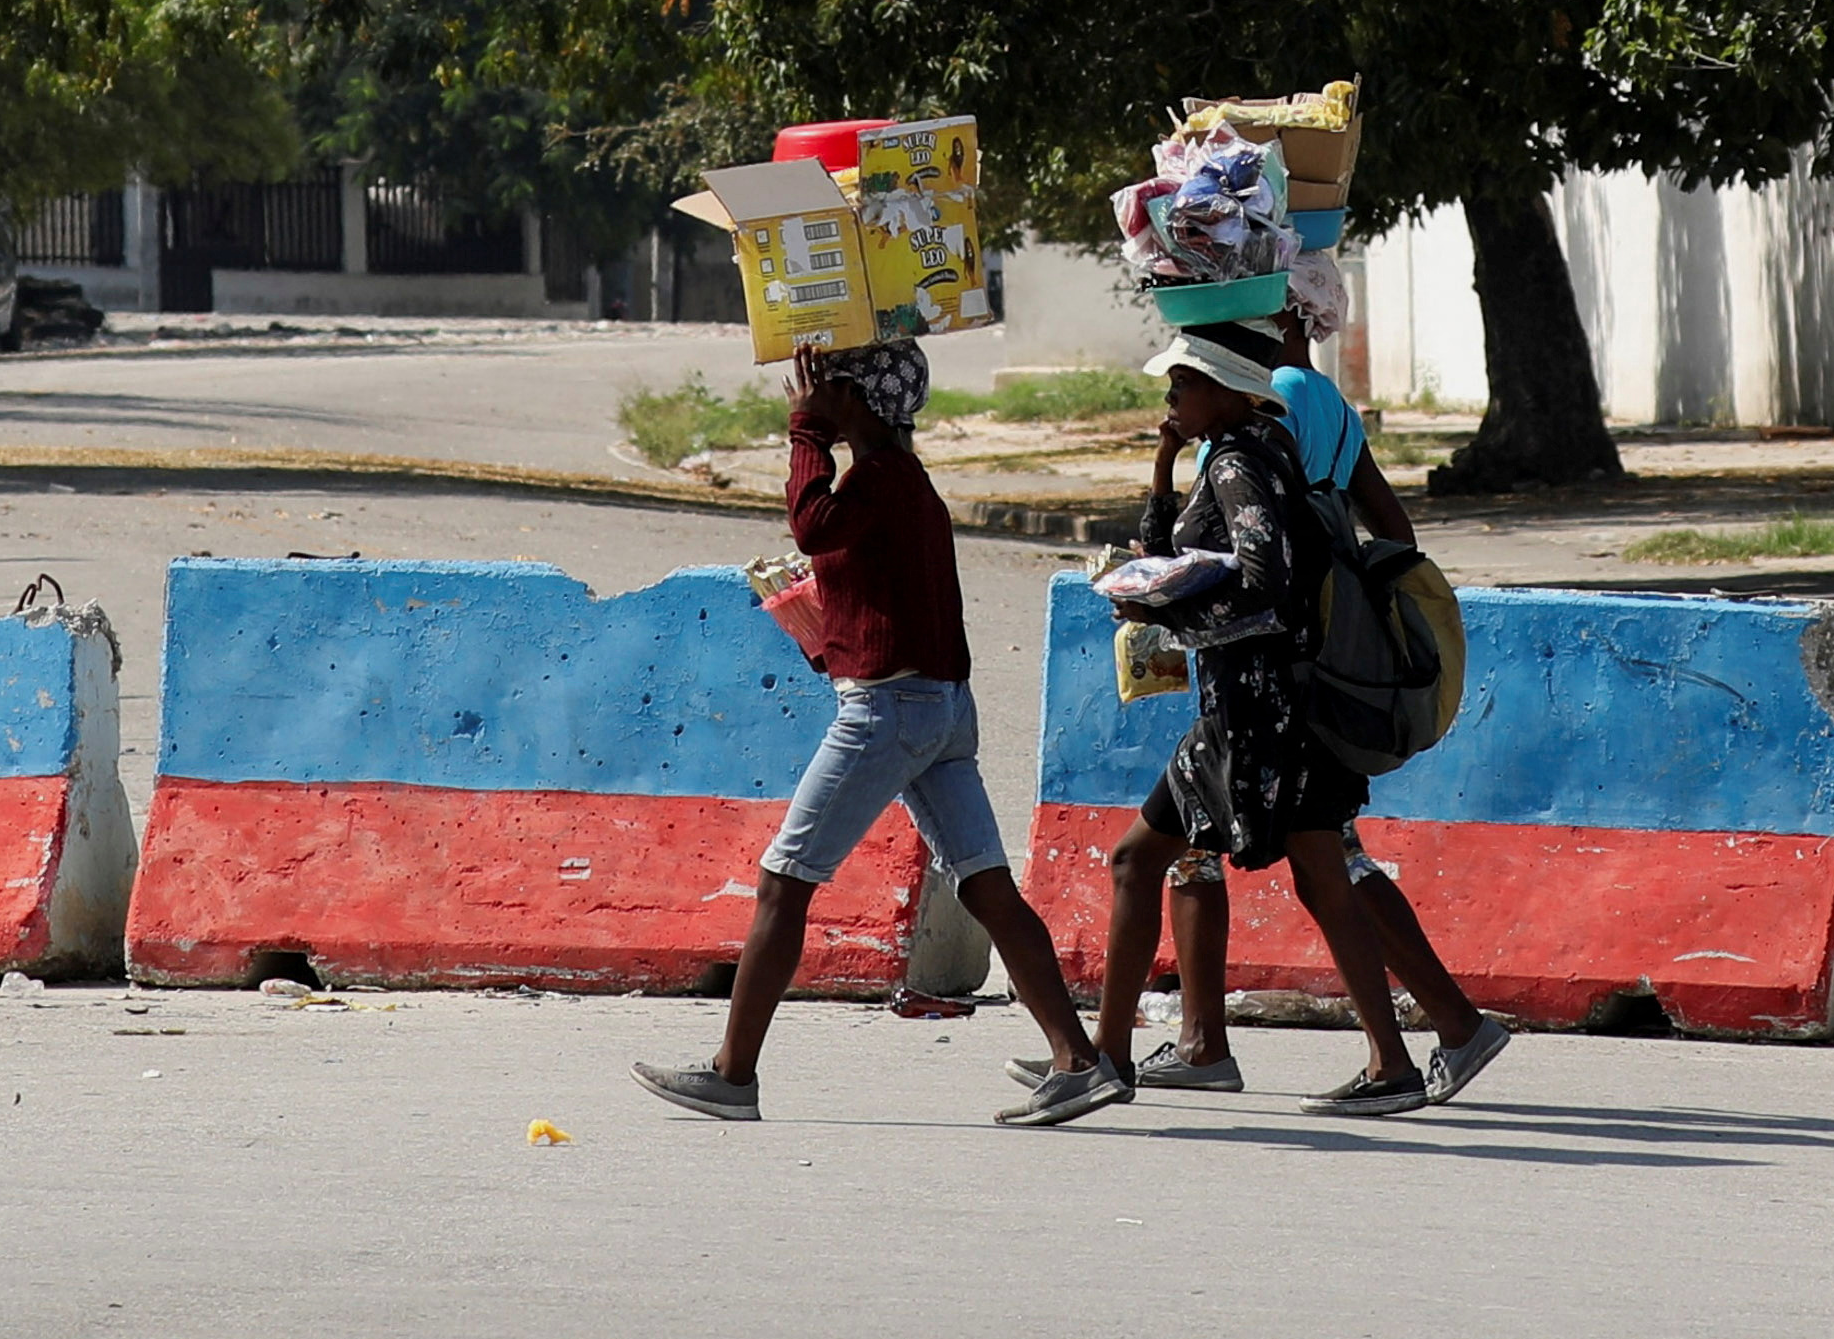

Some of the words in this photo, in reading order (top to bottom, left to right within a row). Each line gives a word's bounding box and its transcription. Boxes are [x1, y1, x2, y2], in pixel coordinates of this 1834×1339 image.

[902, 131, 936, 151] SUPER
[910, 149, 931, 166] LEO
[910, 226, 945, 253] SUPE
[921, 248, 946, 269] LEO
